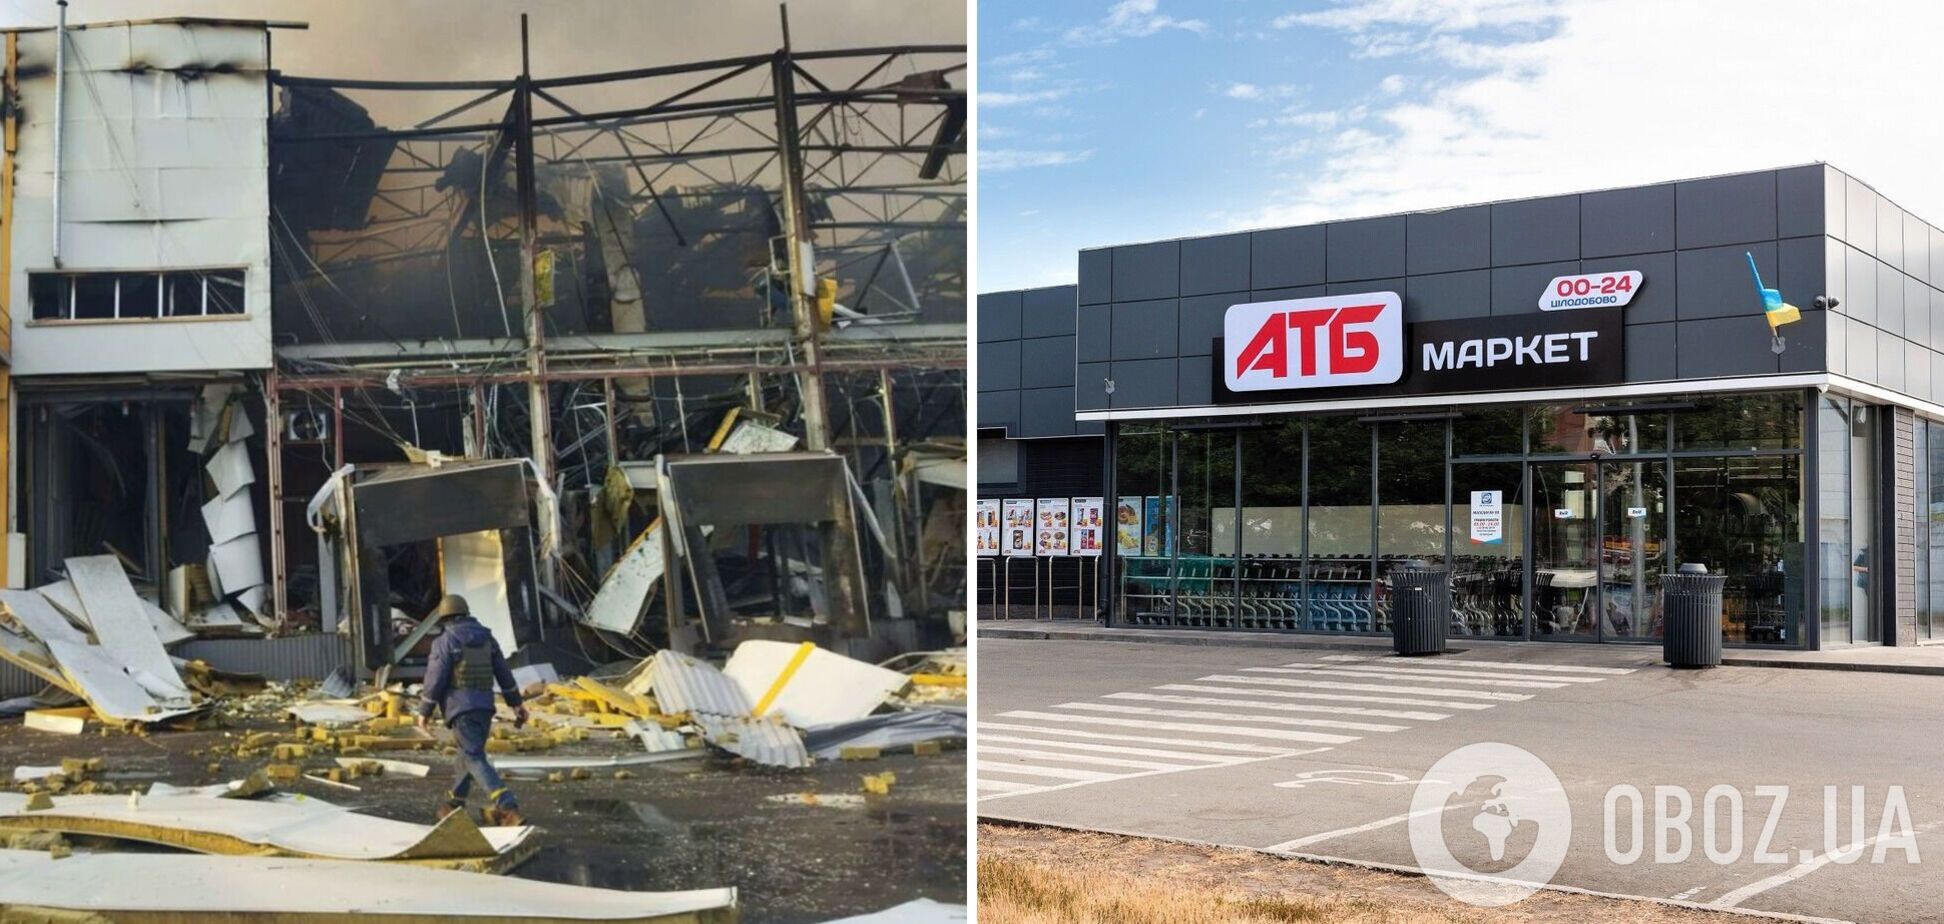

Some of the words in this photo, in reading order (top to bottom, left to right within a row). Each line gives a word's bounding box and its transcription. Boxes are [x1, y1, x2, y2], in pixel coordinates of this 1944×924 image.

[1557, 275, 1632, 297] 00-24
[1550, 295, 1618, 308] ЦІЛОДОБОВО
[1236, 304, 1387, 380] АТБ
[1422, 331, 1599, 372] МАРКЕТ
